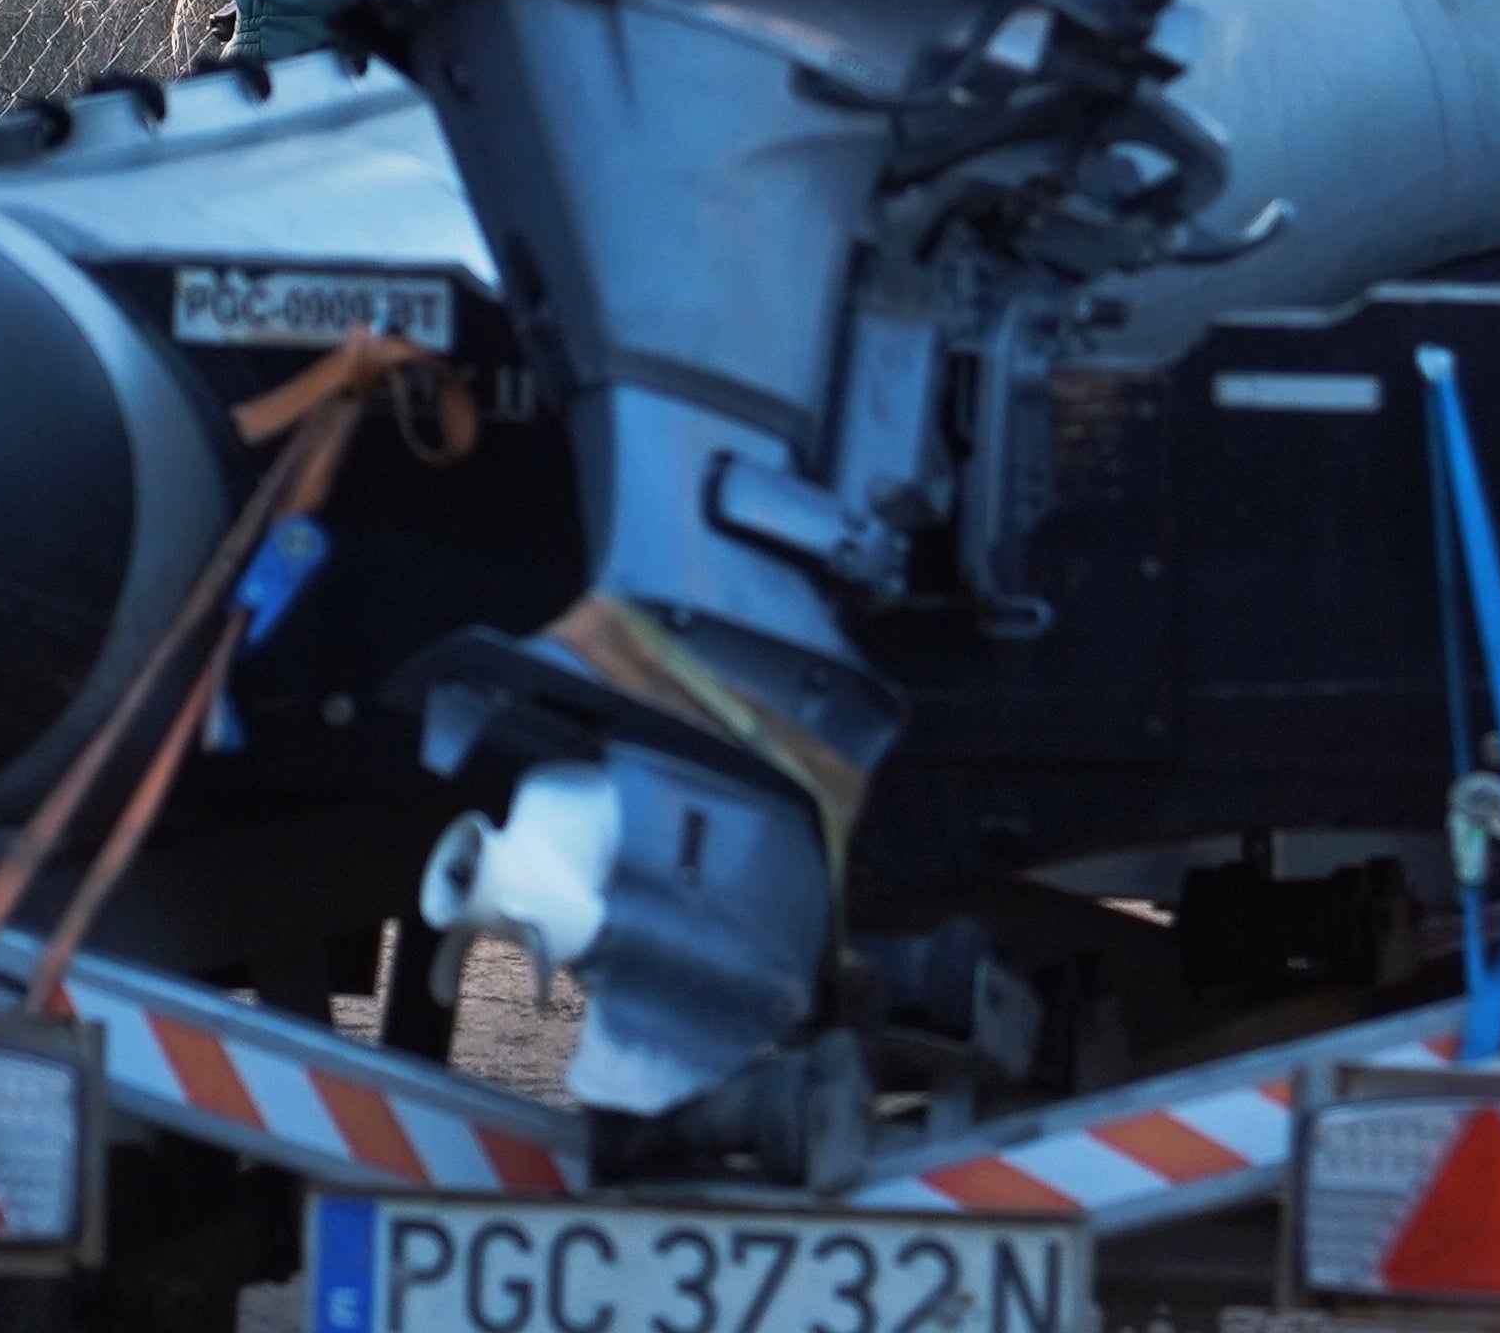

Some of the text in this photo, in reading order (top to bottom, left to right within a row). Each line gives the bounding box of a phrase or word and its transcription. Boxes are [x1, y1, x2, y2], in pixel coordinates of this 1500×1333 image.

[388, 1217, 1065, 1333] PGC 3732 N
